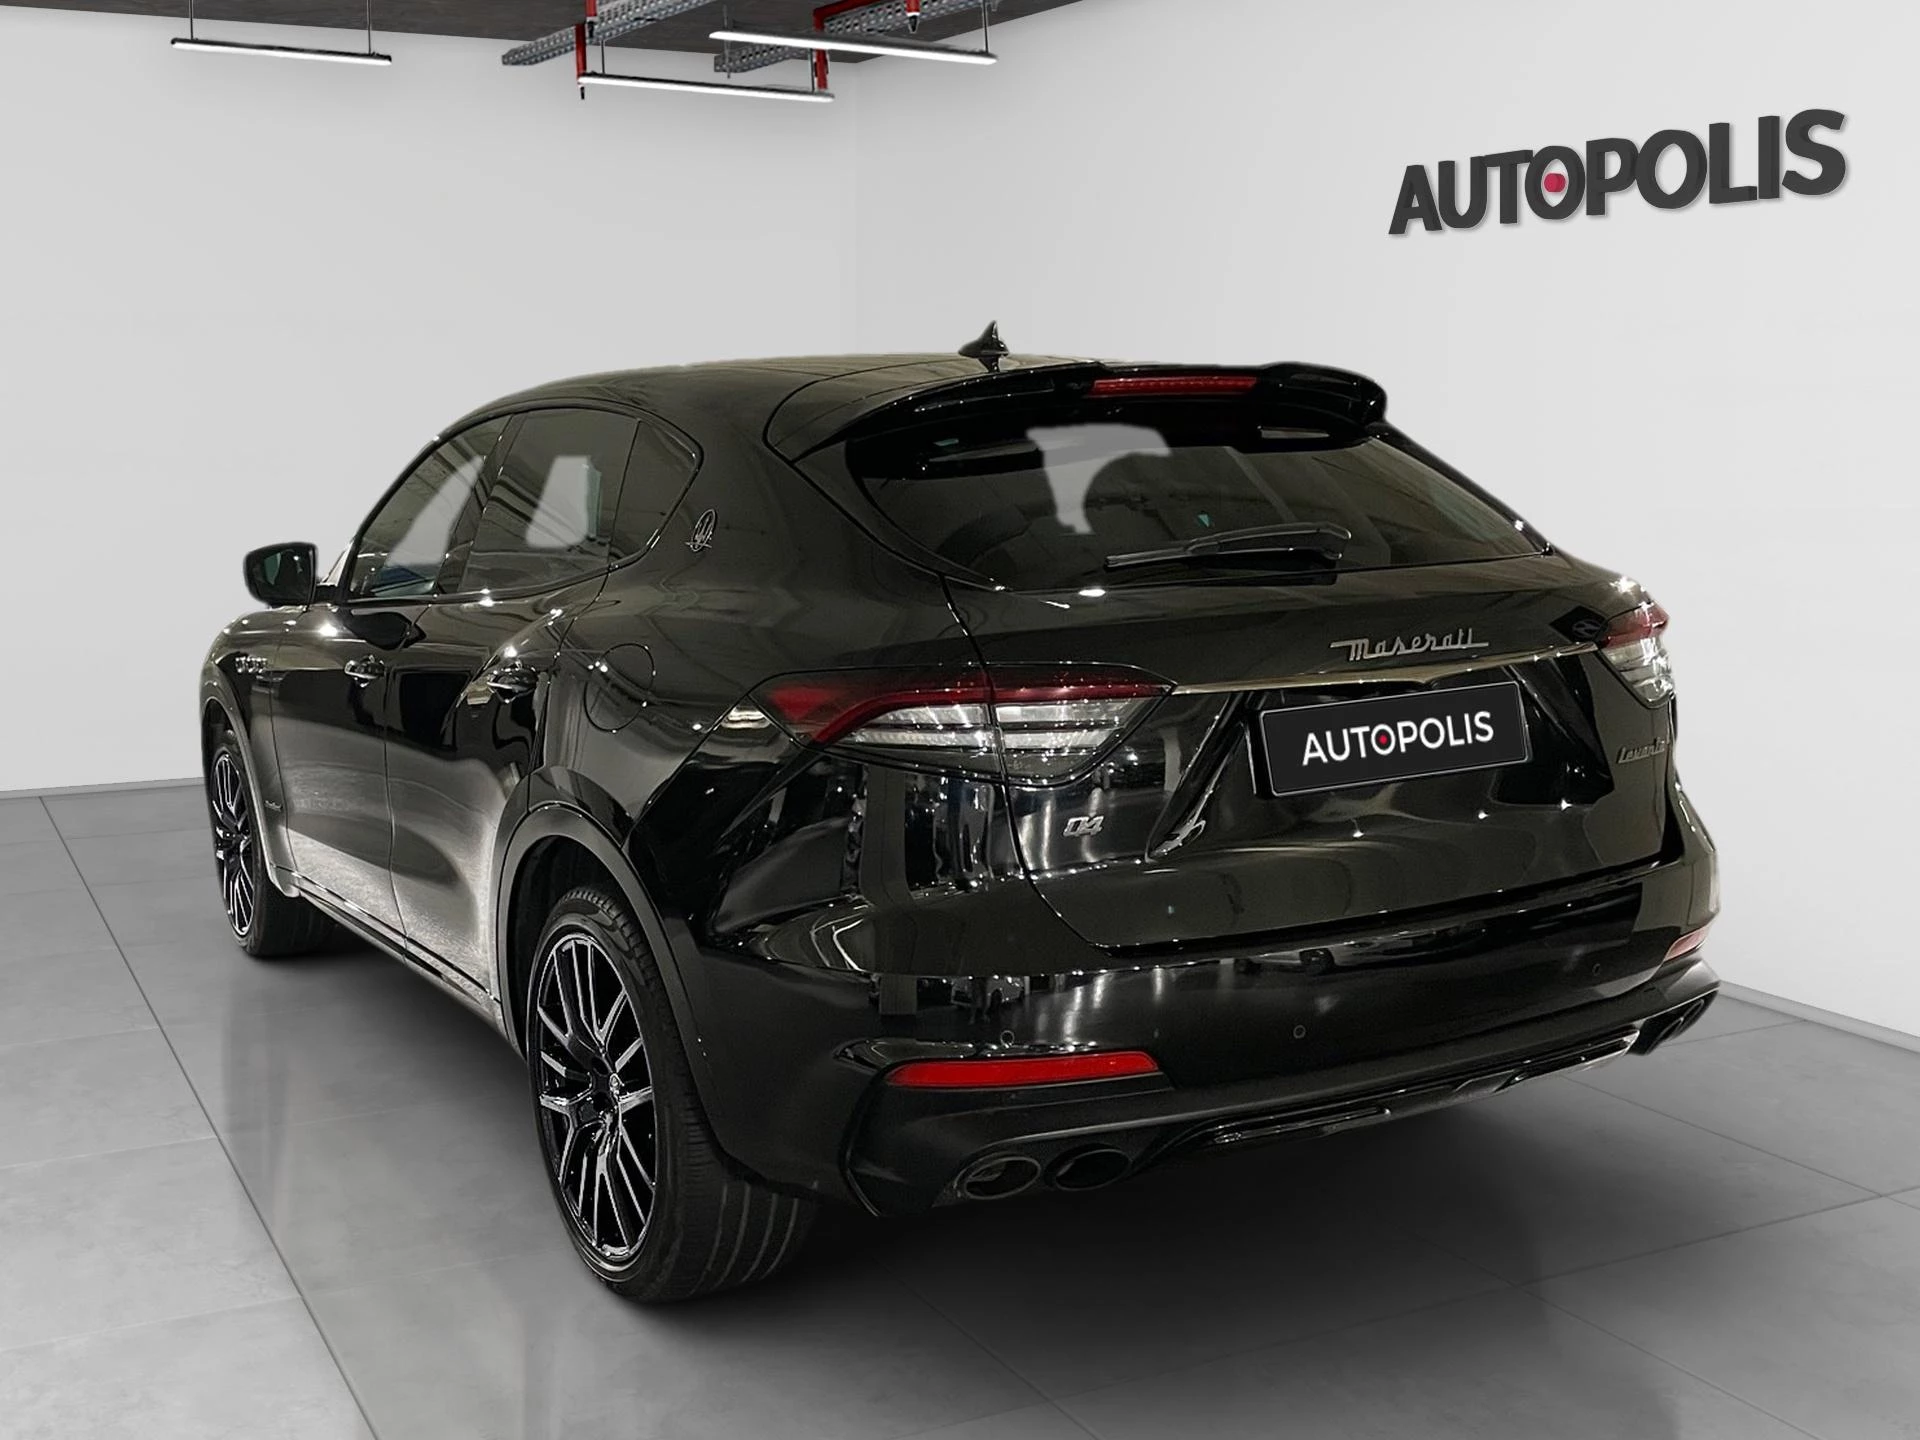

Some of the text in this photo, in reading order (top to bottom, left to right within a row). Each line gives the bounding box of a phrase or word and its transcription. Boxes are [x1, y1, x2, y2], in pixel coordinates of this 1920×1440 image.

[1388, 108, 1847, 235] AUTOPOLIS
[1330, 628, 1489, 661] Maserati
[1302, 711, 1494, 766] AUTOPOLIS
